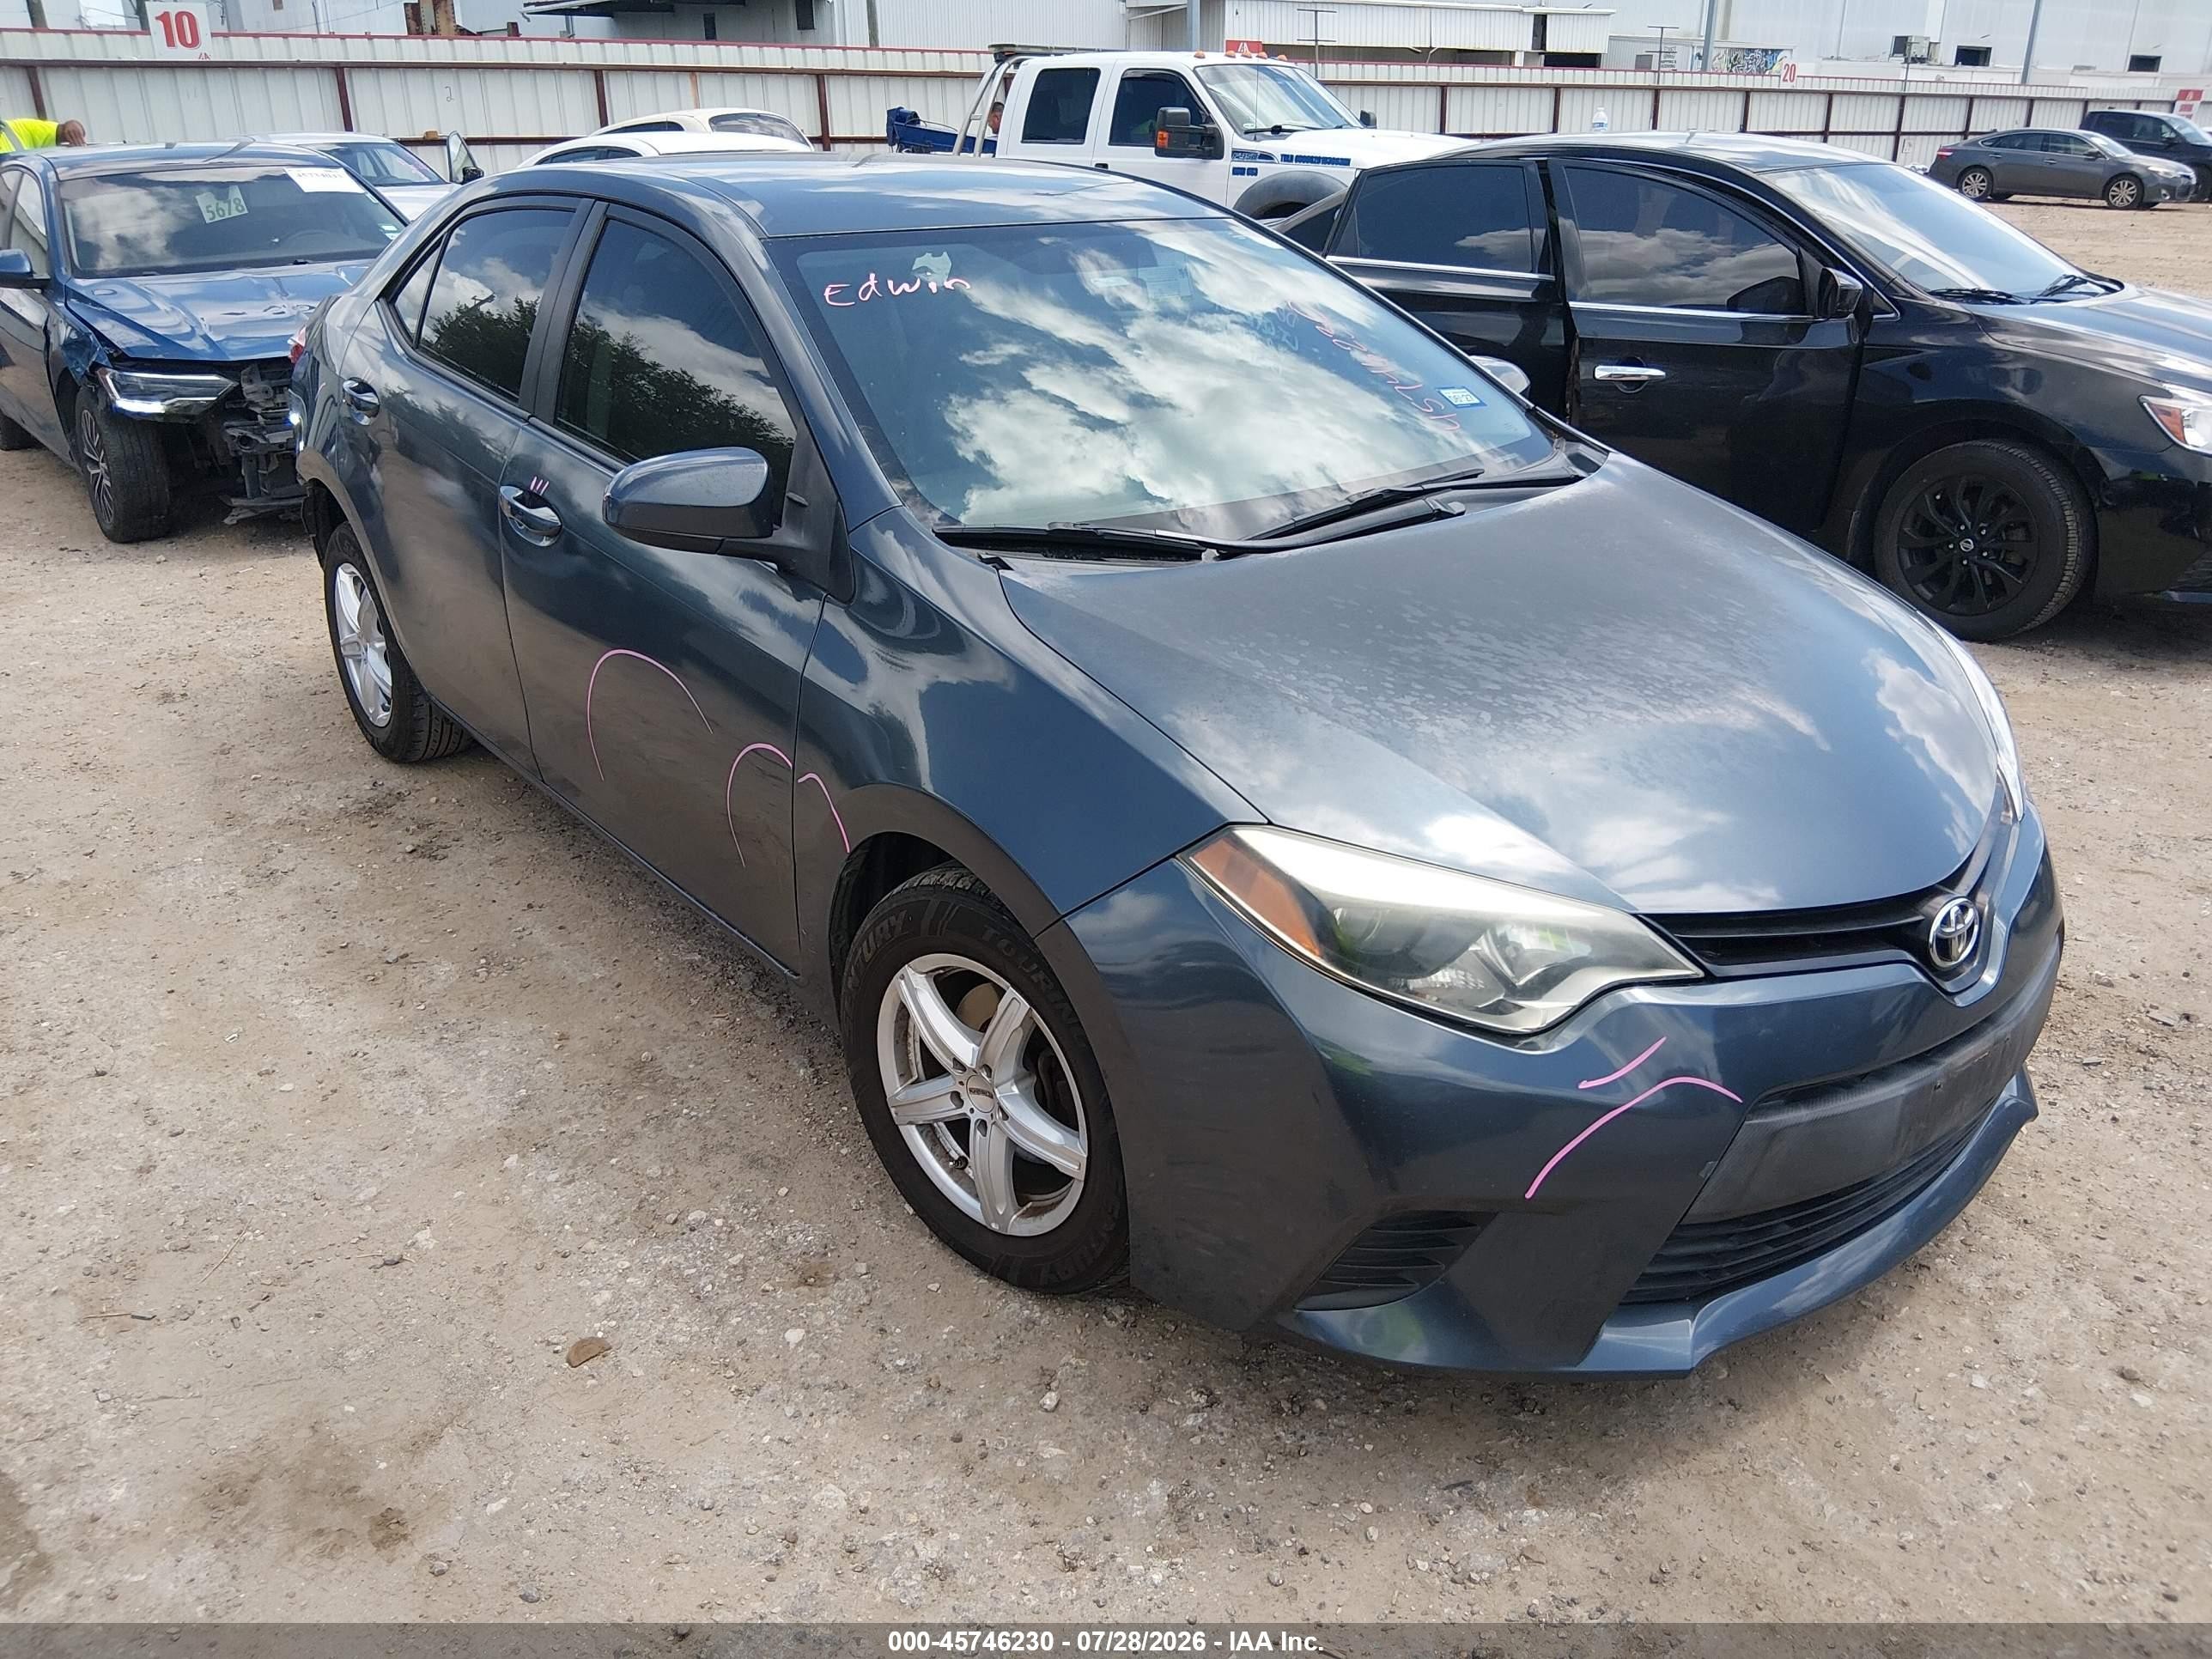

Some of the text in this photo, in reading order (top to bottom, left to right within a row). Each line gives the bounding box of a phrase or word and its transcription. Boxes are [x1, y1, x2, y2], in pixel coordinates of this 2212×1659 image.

[155, 11, 201, 48] 10
[1782, 64, 1796, 83] 20
[205, 198, 246, 222] 5678
[823, 272, 971, 307] Edwin
